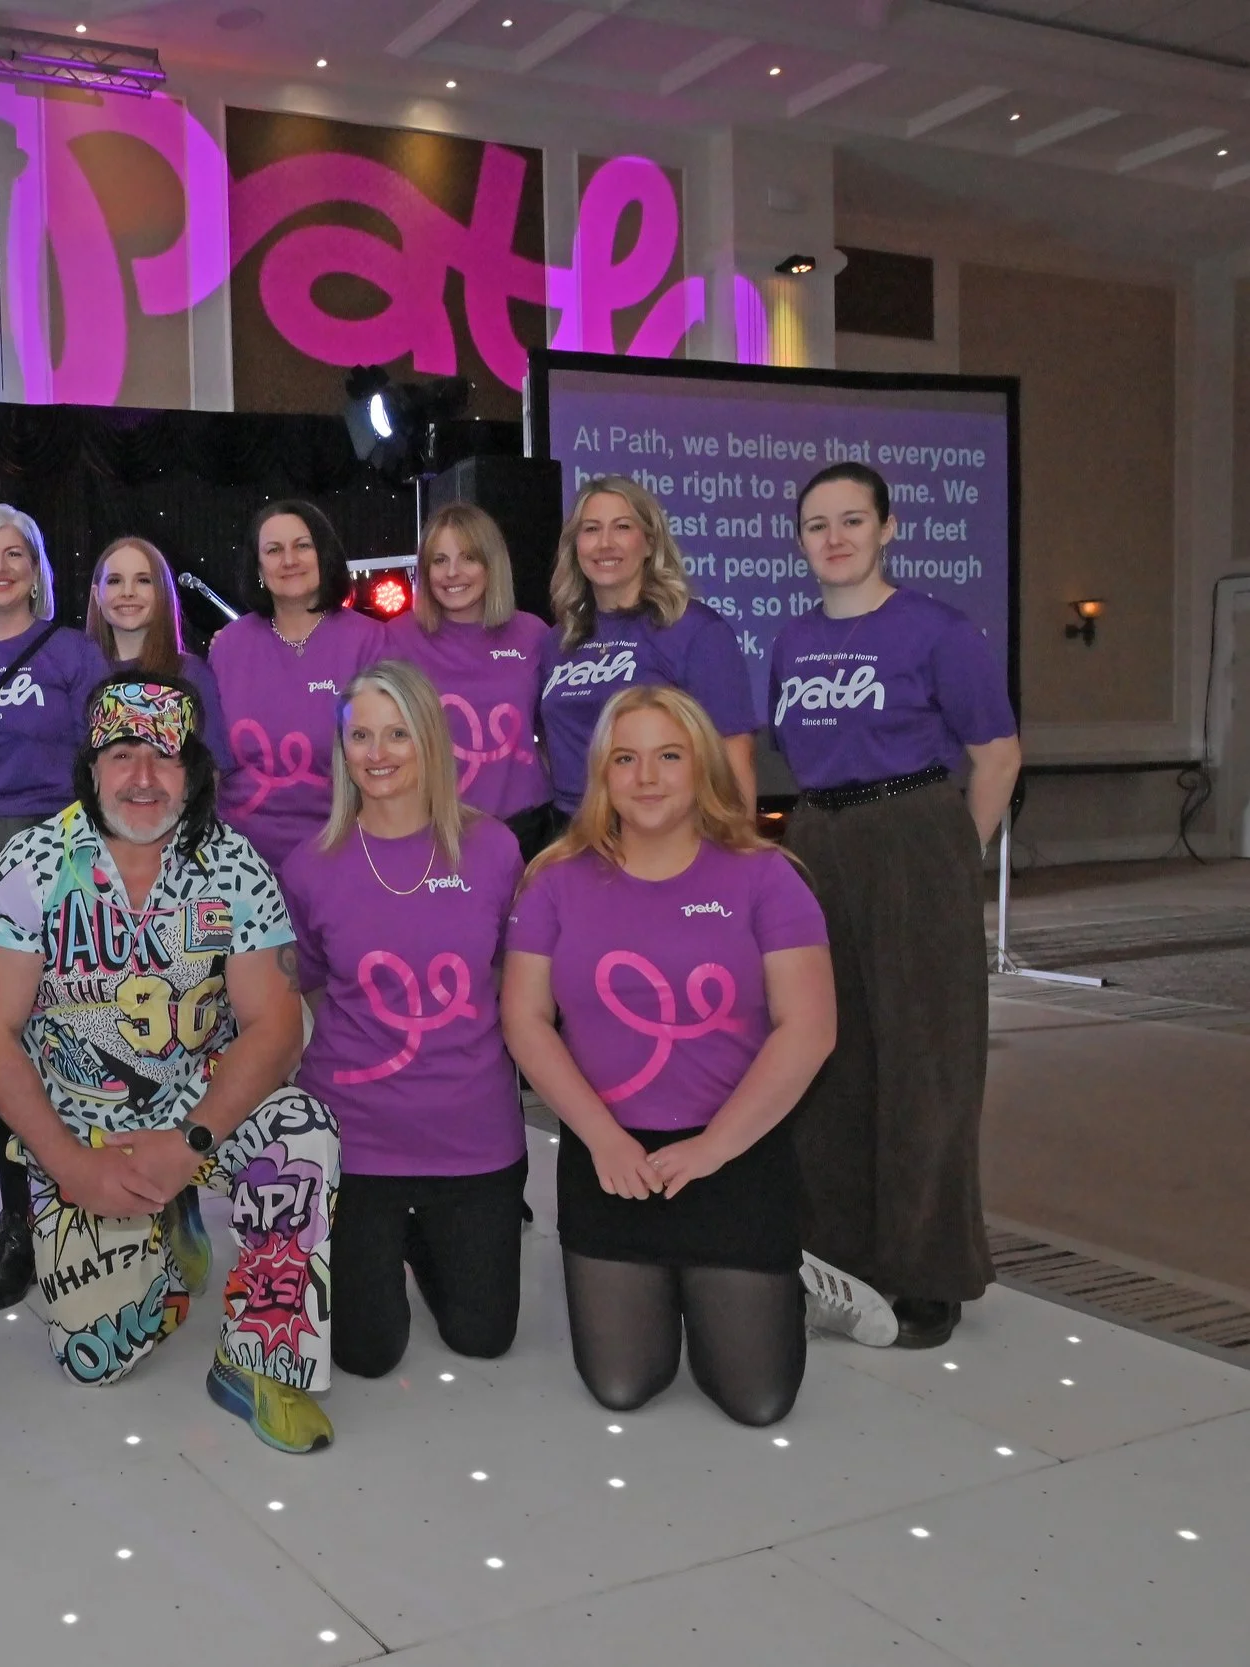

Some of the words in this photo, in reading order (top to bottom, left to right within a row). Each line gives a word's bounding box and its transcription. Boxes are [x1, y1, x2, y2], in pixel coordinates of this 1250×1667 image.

[574, 426, 600, 452] At
[609, 427, 674, 459] Path,
[682, 435, 719, 457] we
[728, 432, 817, 460] believe
[824, 437, 870, 463] that
[878, 445, 986, 472] everyone
[632, 468, 675, 495] the
[683, 471, 743, 503] right
[751, 475, 775, 499] to
[783, 481, 797, 500] a
[943, 480, 979, 504] We
[665, 511, 707, 537] ast
[716, 514, 762, 538] and
[924, 516, 967, 542] feet
[725, 553, 808, 584] people
[891, 554, 982, 585] through
[751, 596, 782, 616] so
[490, 649, 527, 660] path
[619, 640, 637, 648] Home
[855, 653, 878, 661] Home
[308, 679, 340, 695] path
[542, 651, 637, 699] path
[774, 665, 885, 726] path
[424, 874, 472, 893] path
[680, 901, 733, 917] path
[63, 978, 112, 1004] THE
[233, 1178, 311, 1231] AP!
